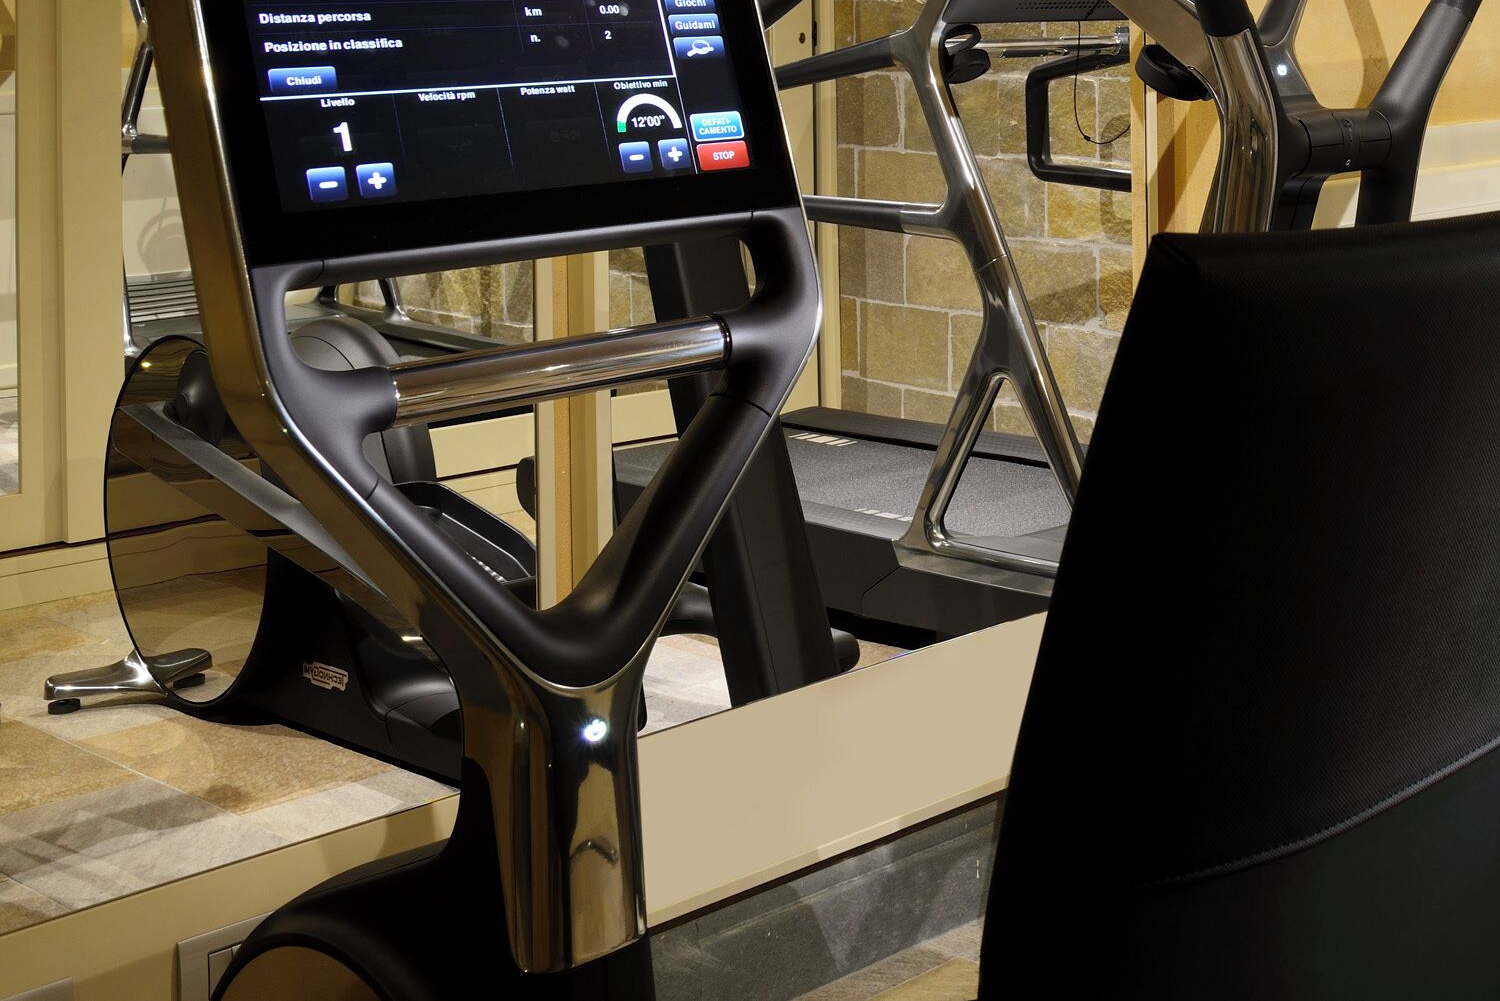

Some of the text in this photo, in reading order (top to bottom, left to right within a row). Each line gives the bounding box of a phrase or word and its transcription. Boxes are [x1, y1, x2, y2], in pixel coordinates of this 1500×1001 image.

[524, 4, 620, 17] km 0.00
[258, 11, 372, 25] Distanza percorsa
[674, 19, 716, 31] Guidami
[530, 29, 613, 43] n. 2
[263, 37, 404, 53] Posizione in classifica
[286, 75, 322, 87] Chiudi
[613, 78, 668, 91] Obiettivo min
[418, 89, 476, 102] Velocità rpm
[520, 84, 576, 96] Potenza watt
[320, 97, 356, 108] Livello
[332, 121, 353, 152] 1
[698, 125, 738, 136] CAMENTO
[712, 150, 736, 162] STOP
